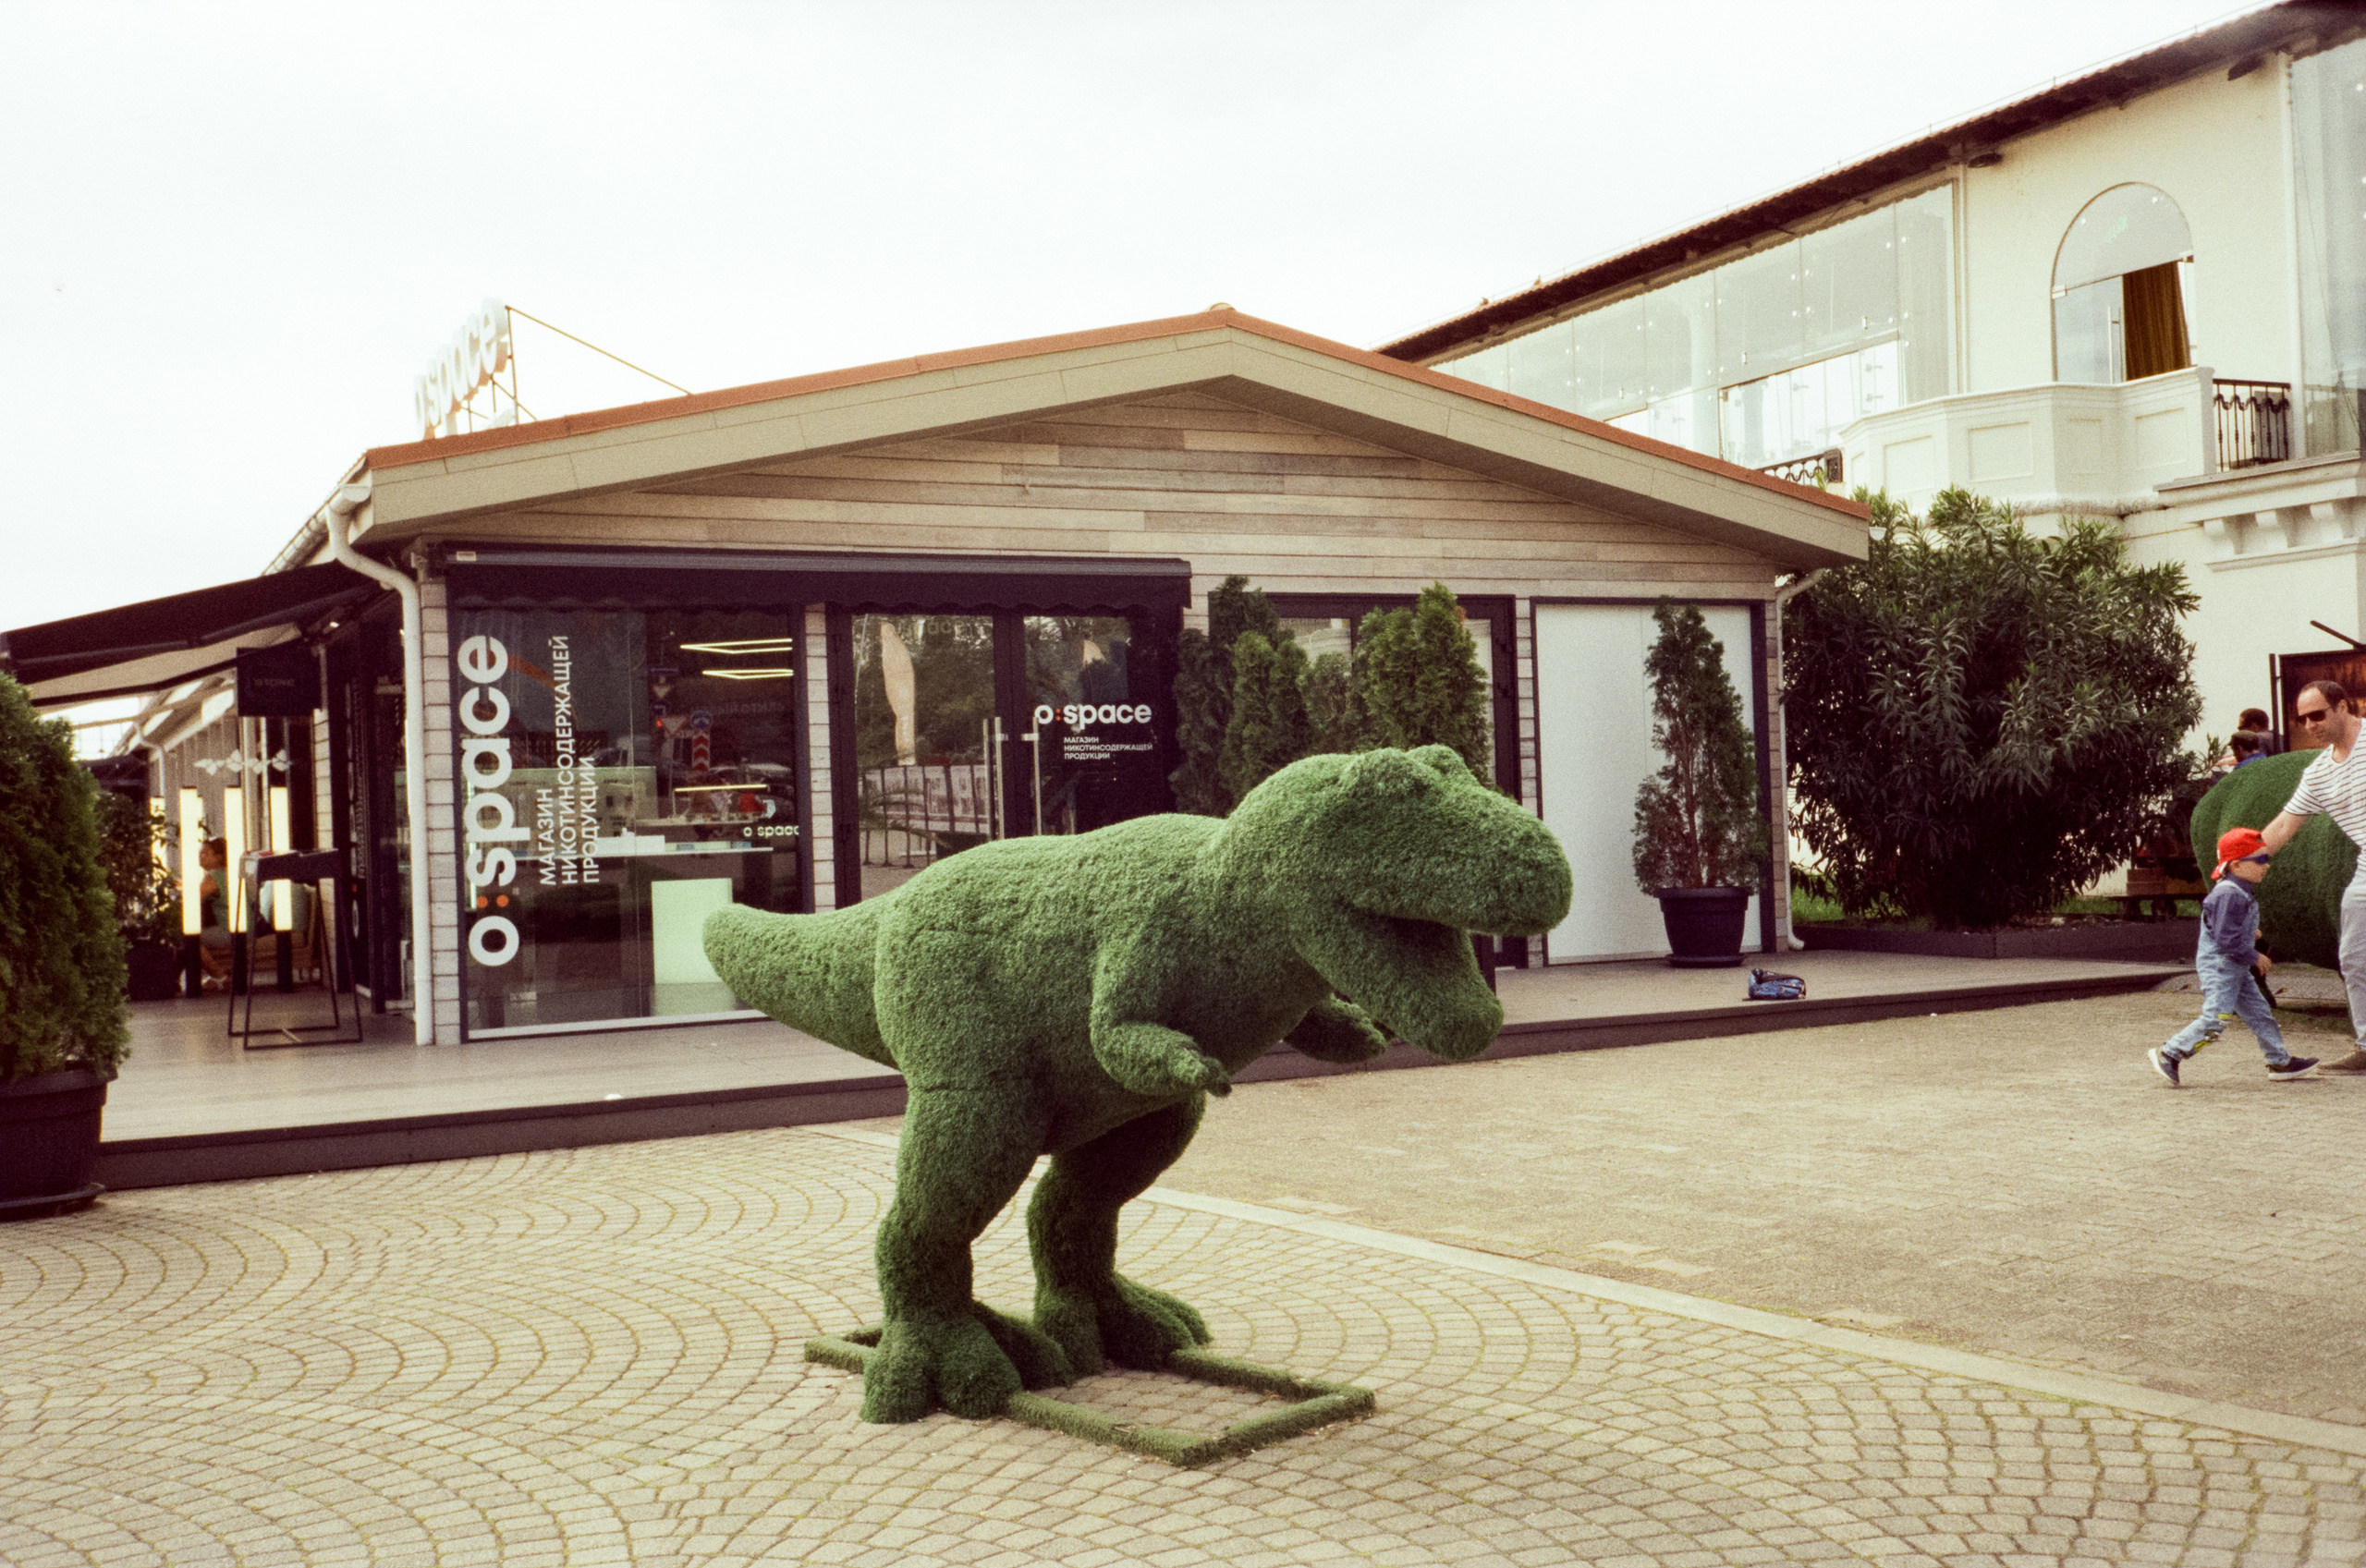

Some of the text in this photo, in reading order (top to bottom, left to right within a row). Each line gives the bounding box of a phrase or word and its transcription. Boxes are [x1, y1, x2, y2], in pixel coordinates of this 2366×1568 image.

[549, 636, 579, 885] НИКОТИНСОДЕРЖАЩЕЙ
[1064, 743, 1153, 752] НИКОТИНСОДЕРЖАЩЕЙ
[1064, 752, 1110, 760] ПРОДУКЦИИ
[536, 788, 557, 886] МАГАЗИН
[579, 757, 600, 884] ПРОДУКЦИИ
